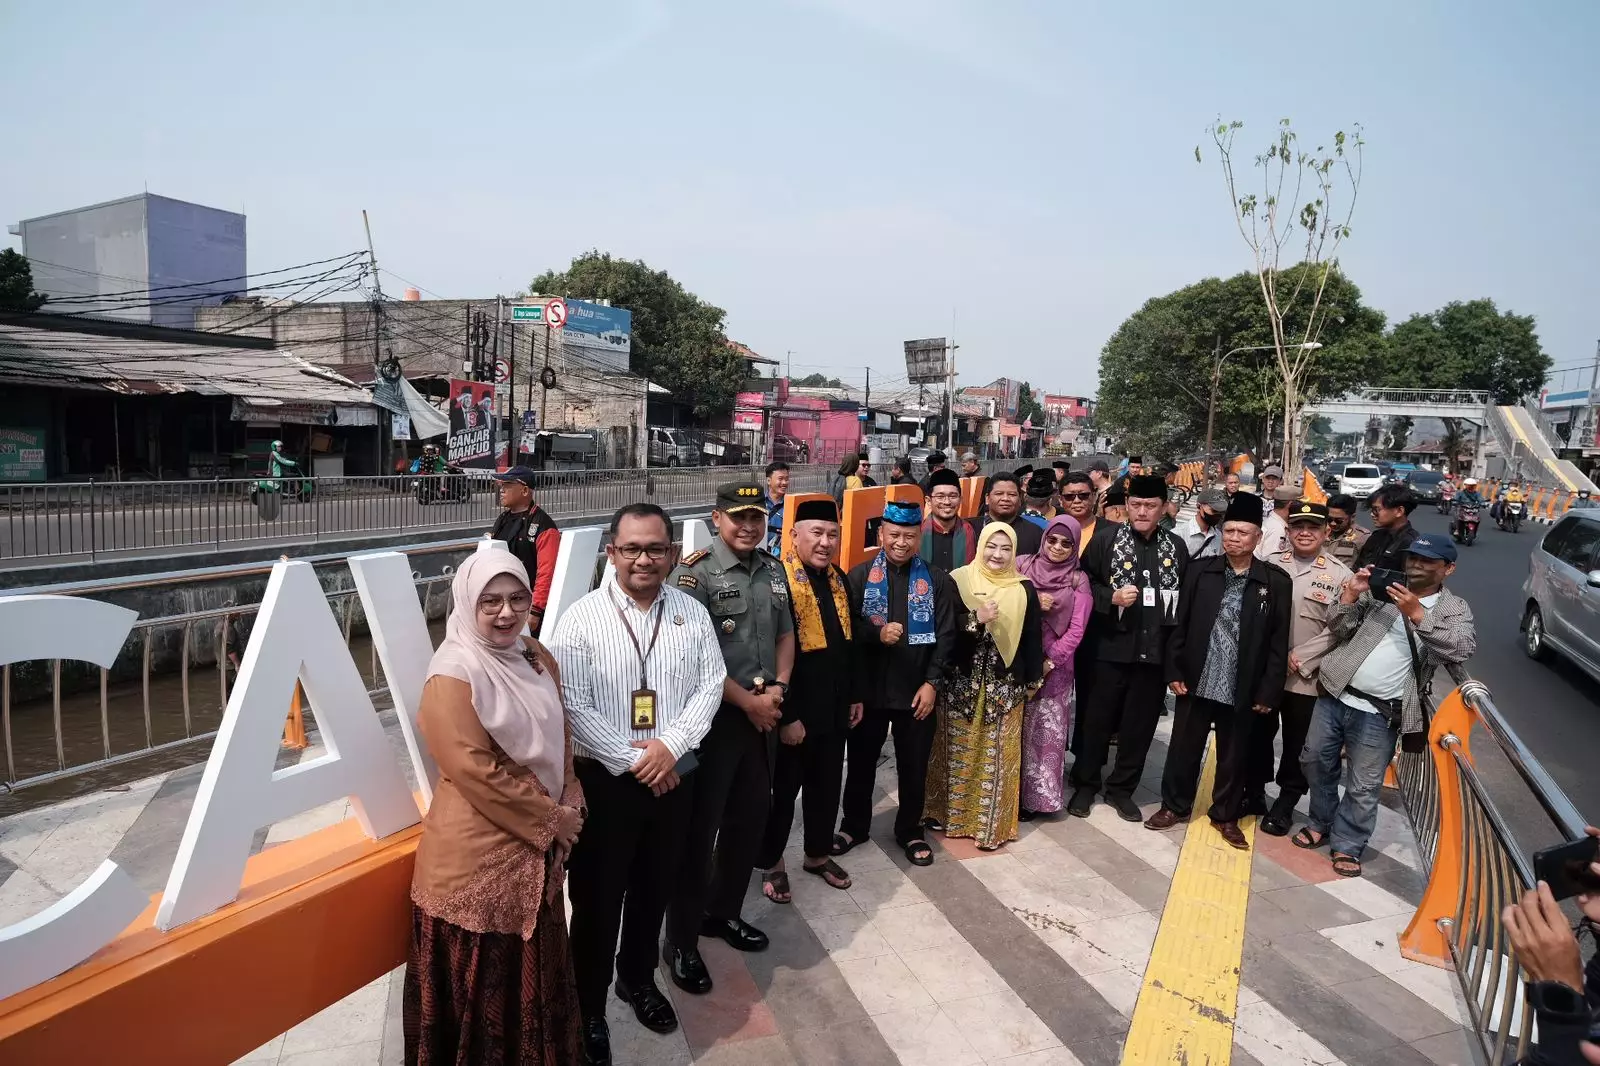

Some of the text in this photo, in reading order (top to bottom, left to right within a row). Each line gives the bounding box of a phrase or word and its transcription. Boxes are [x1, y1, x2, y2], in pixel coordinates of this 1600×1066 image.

[449, 429, 490, 449] GANJAR
[448, 441, 490, 461] MAHFUD
[1311, 581, 1334, 592] POLRI
